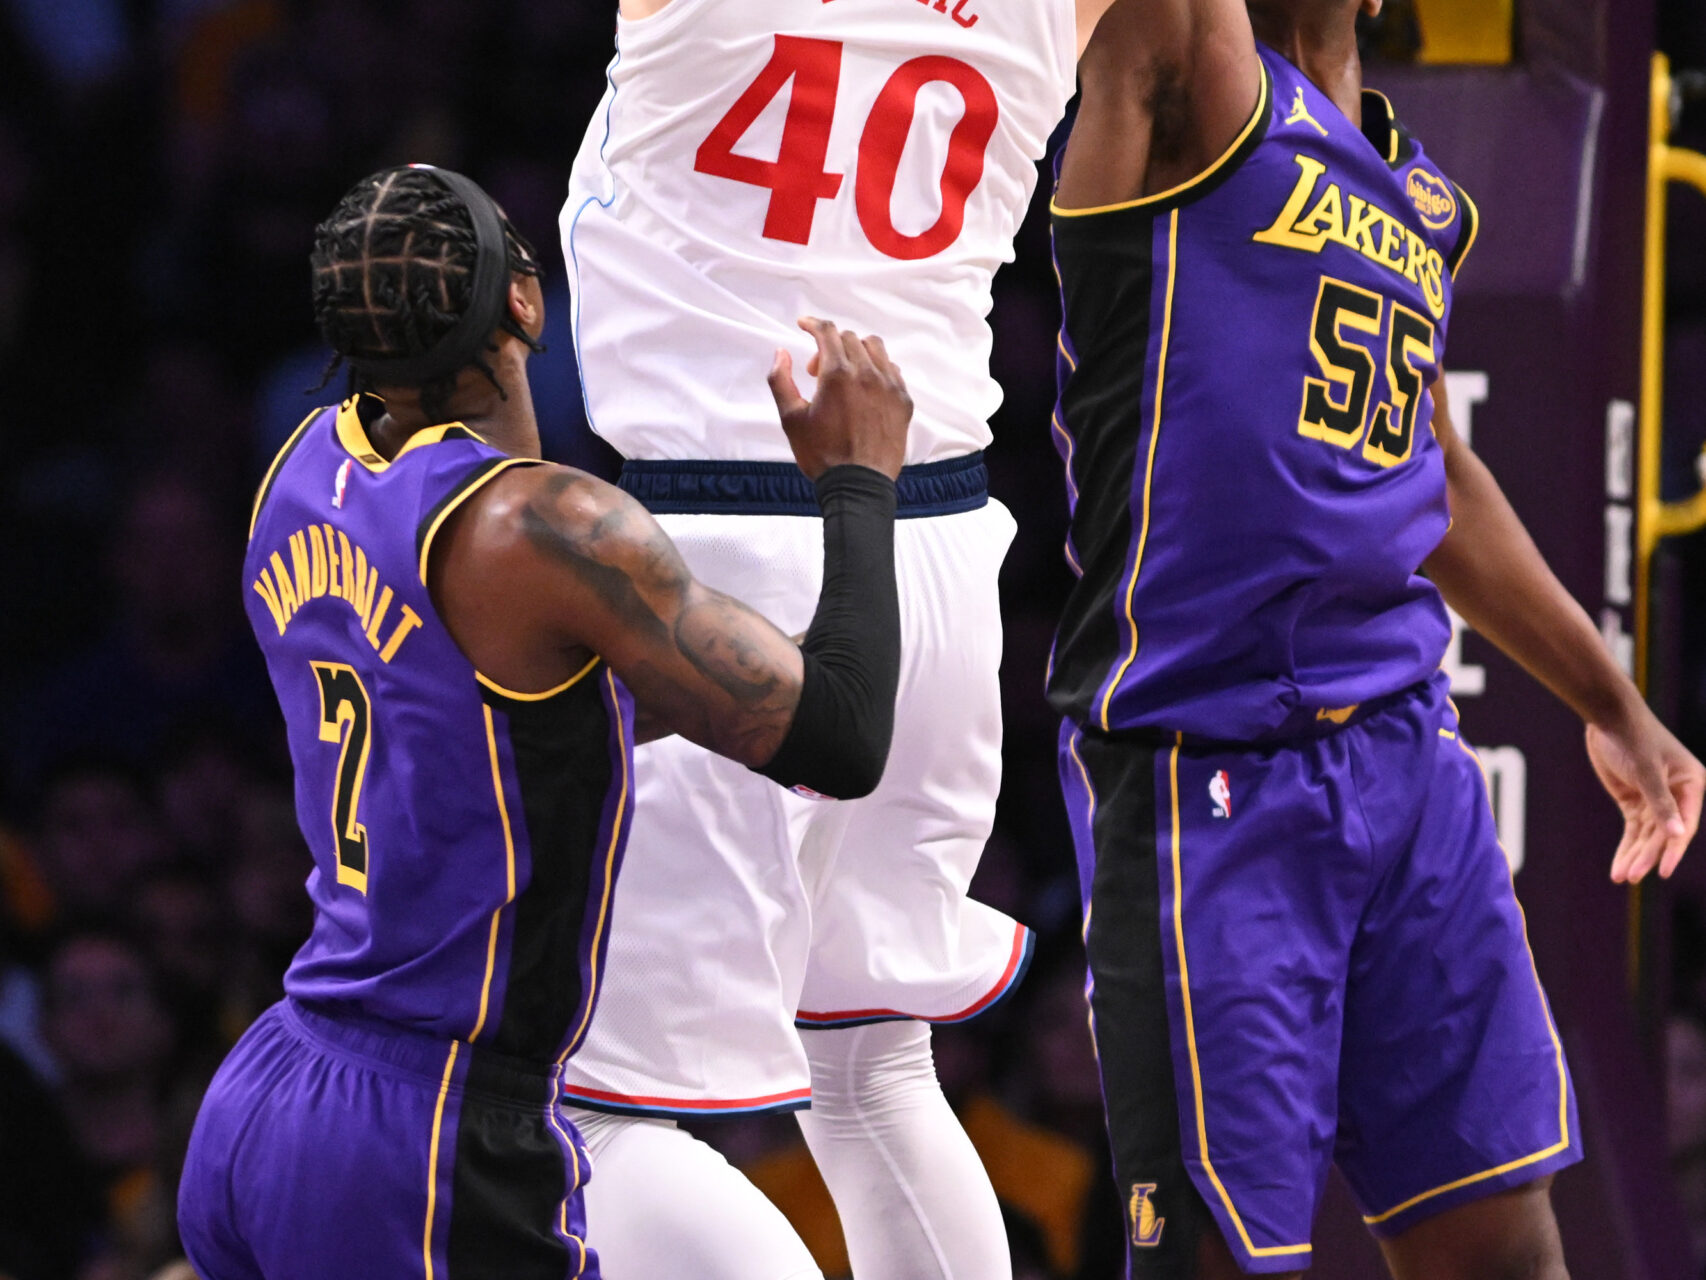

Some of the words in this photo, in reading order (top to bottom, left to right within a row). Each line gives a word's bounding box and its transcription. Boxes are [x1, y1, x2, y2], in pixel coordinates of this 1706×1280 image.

[693, 32, 1000, 261] 40
[1252, 152, 1445, 320] LAKERS
[1296, 274, 1436, 469] 55
[252, 522, 424, 664] VANDERBILT
[308, 659, 371, 897] 2
